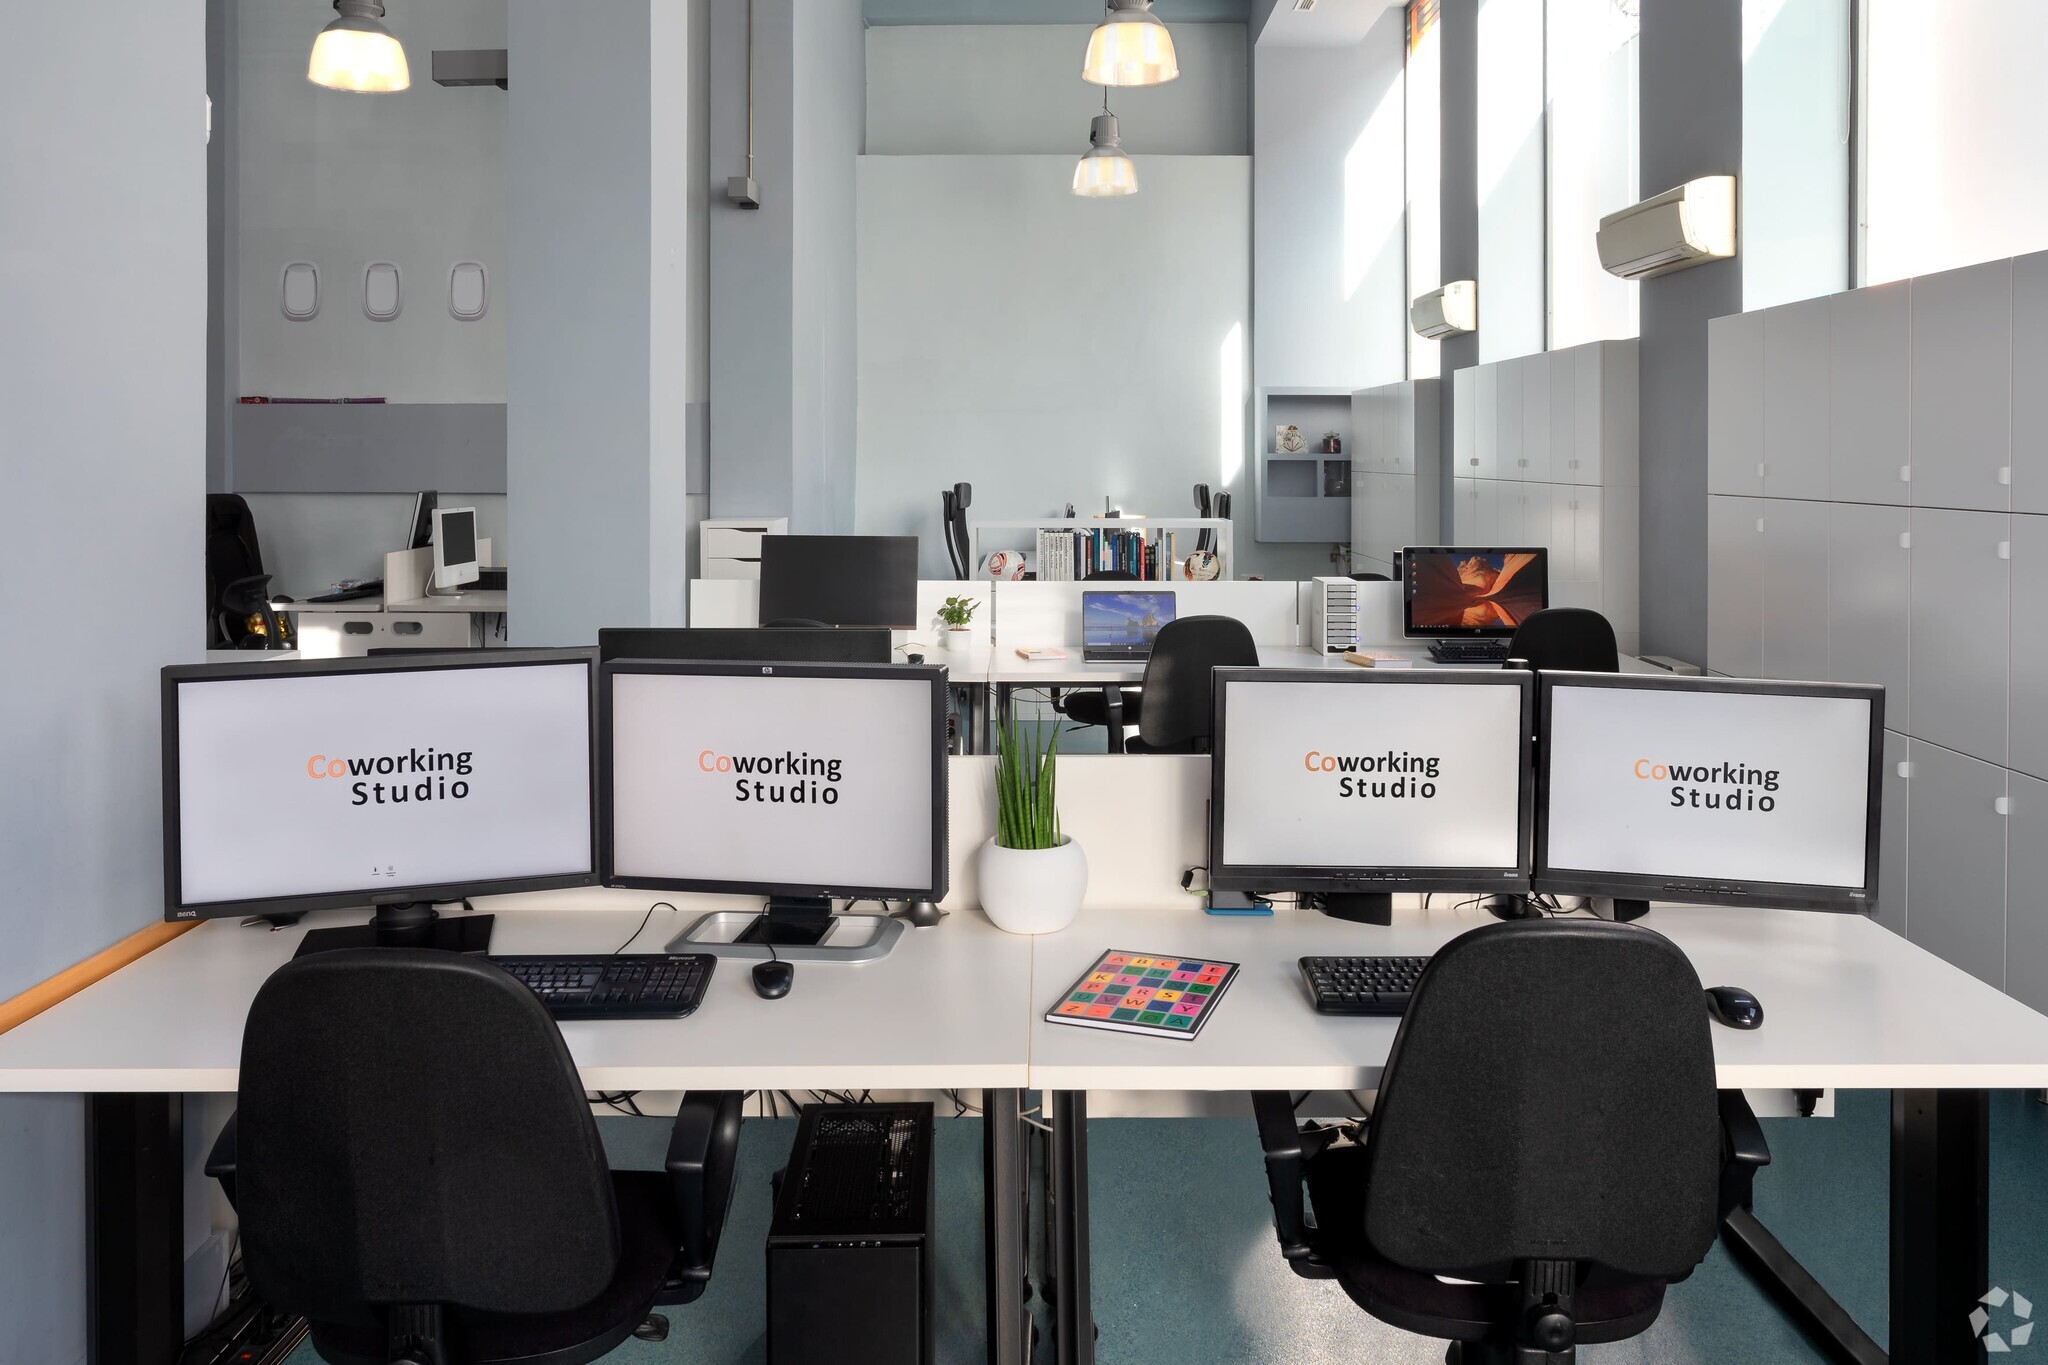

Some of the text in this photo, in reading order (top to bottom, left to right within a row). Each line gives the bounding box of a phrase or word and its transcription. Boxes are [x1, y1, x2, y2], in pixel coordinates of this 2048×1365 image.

[307, 748, 472, 778] Coworking
[698, 750, 842, 782] Coworking
[1305, 751, 1440, 778] Coworking
[1634, 759, 1780, 791] Coworking
[352, 776, 469, 805] Studio
[736, 779, 838, 804] Studio
[1340, 777, 1436, 798] Studio
[1671, 786, 1775, 812] Studio
[1126, 998, 1145, 1006] W
